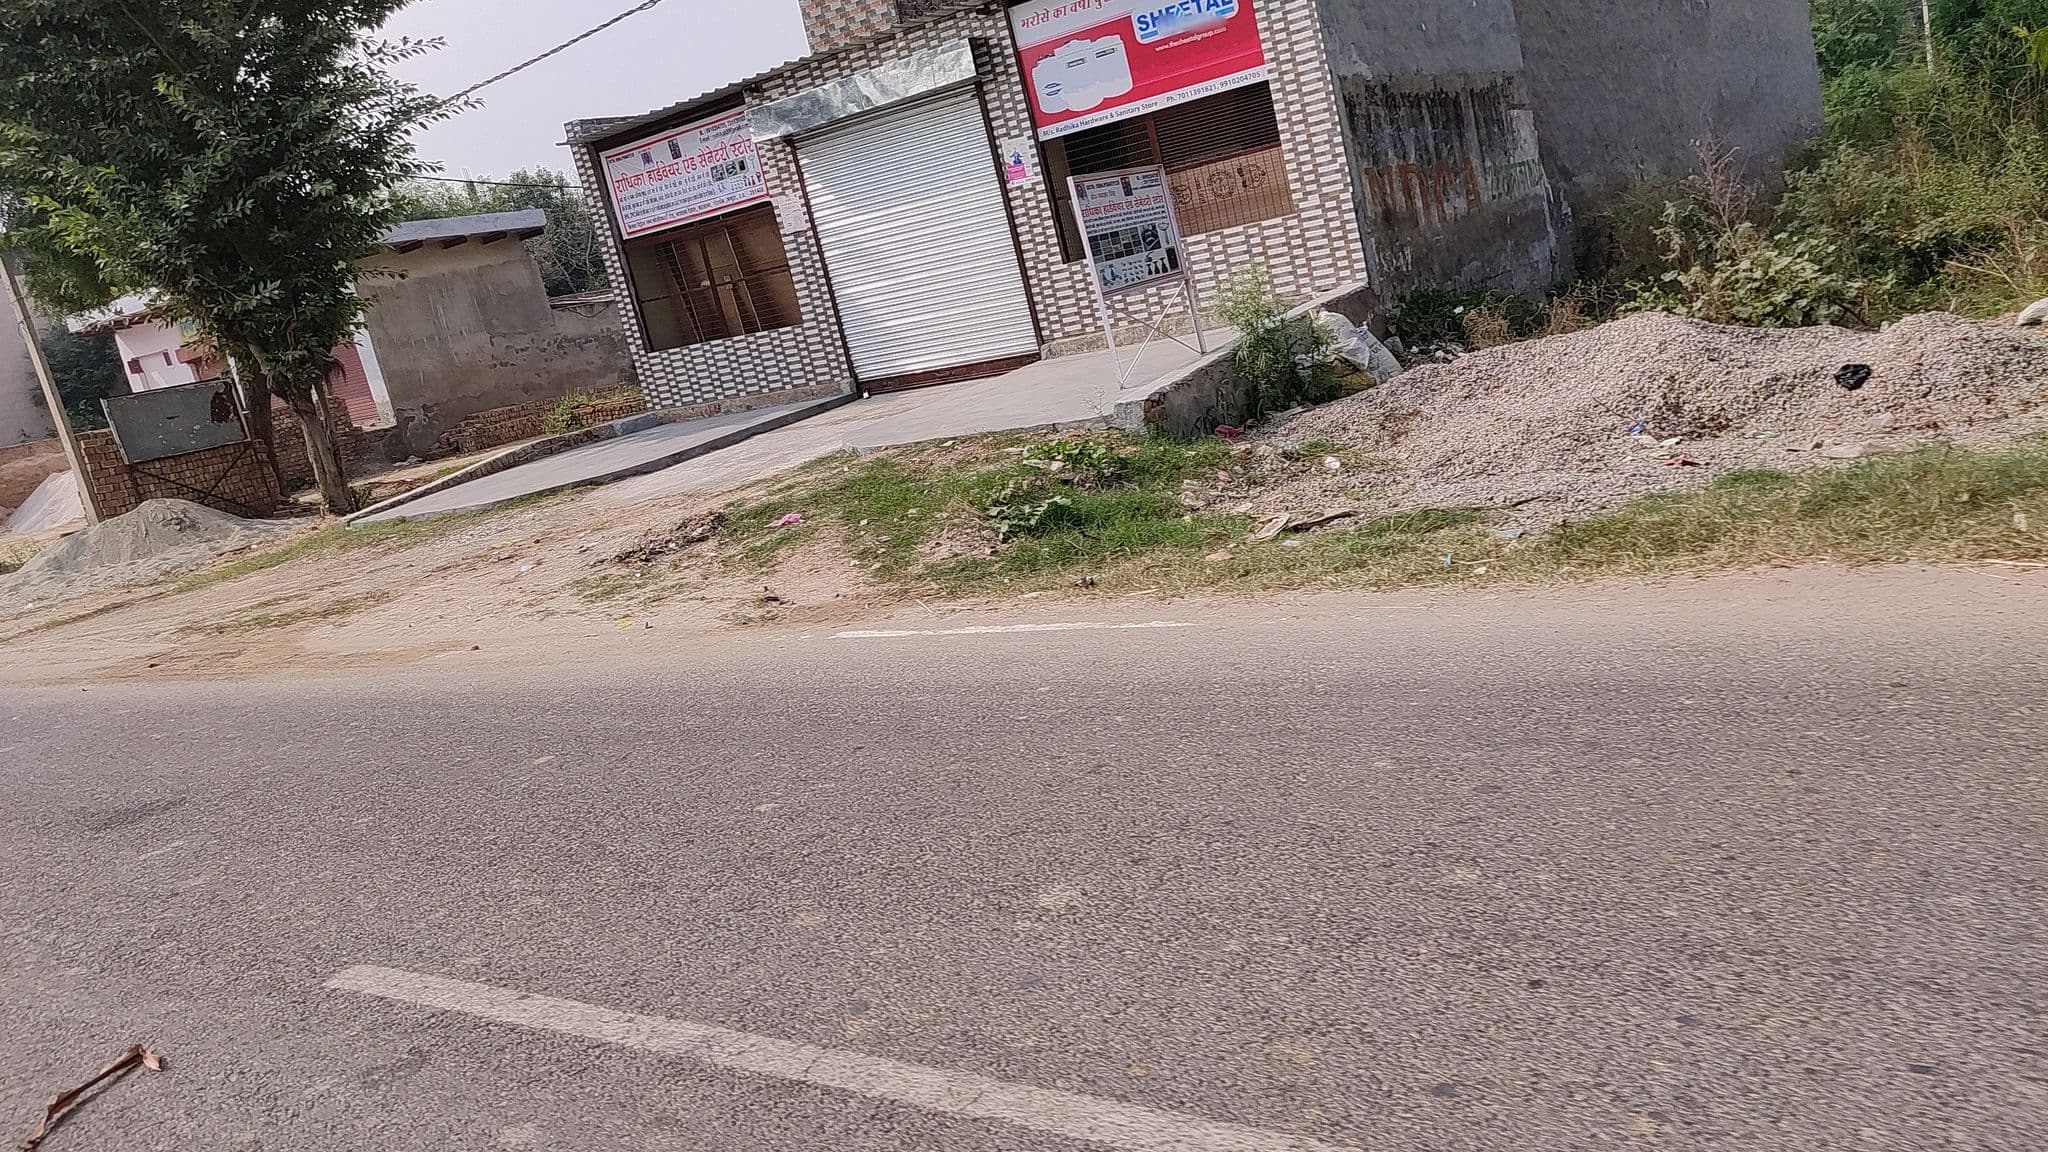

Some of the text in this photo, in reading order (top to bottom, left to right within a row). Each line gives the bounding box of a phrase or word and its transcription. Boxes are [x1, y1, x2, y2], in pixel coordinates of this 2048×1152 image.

[1052, 5, 1068, 19] का
[1055, 121, 1079, 134] Radhika
[1080, 113, 1109, 126] Hardware
[1109, 111, 1115, 119] &
[1114, 106, 1140, 117] Sanitary
[1141, 101, 1158, 110] Store
[1219, 71, 1261, 88] 9910204705
